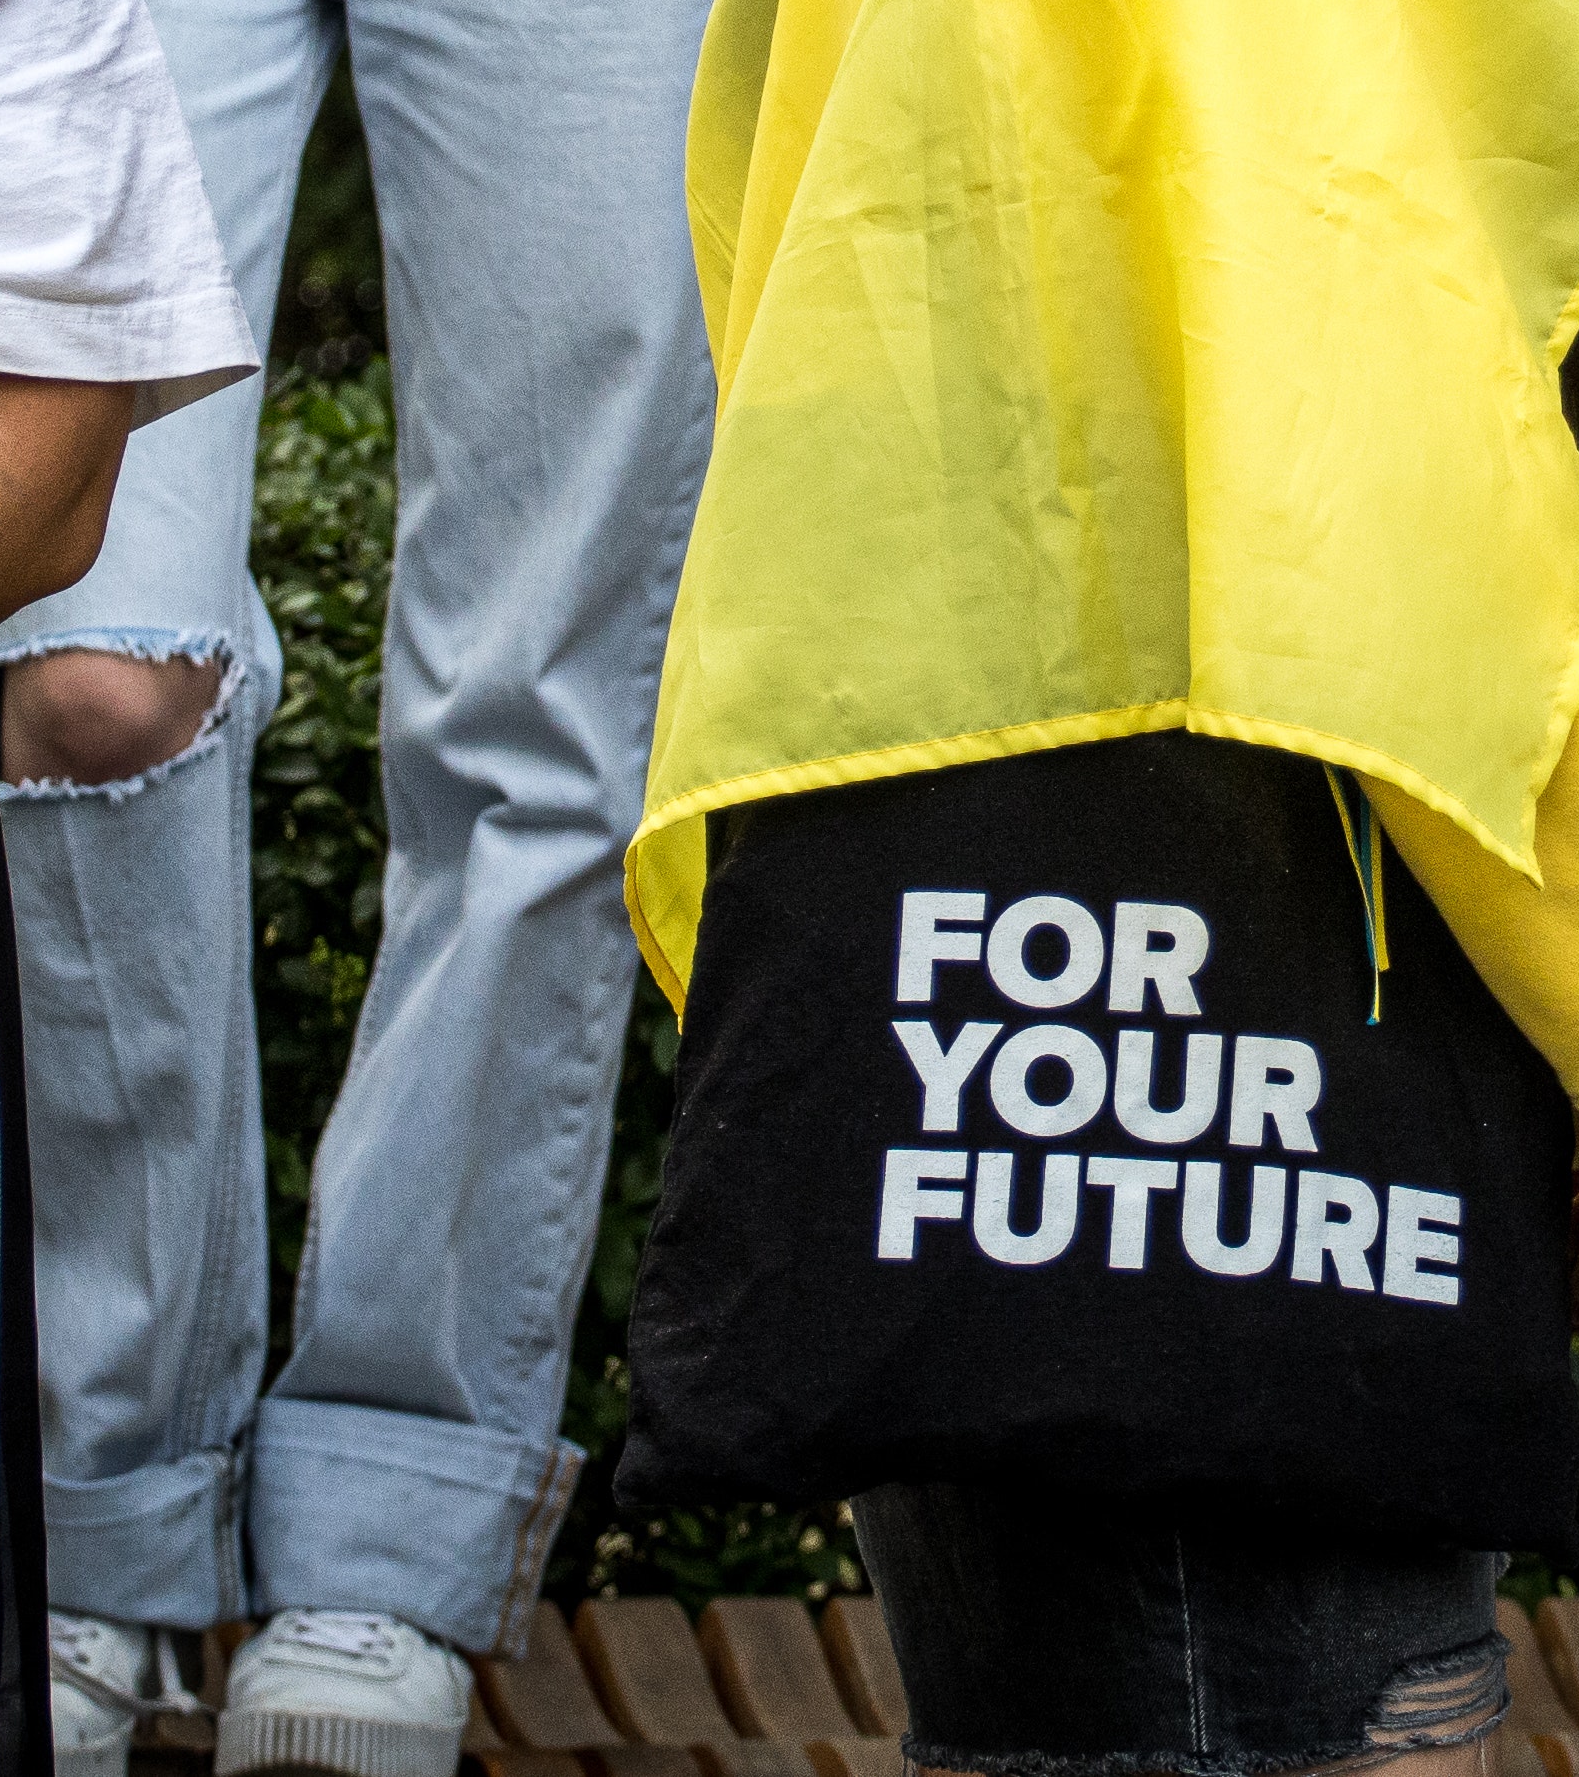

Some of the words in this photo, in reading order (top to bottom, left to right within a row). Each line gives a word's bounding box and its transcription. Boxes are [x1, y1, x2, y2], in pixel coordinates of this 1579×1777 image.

[896, 891, 1210, 1016] FOR
[891, 1021, 1323, 1153] YOUR
[877, 1148, 1463, 1306] FUTURE
